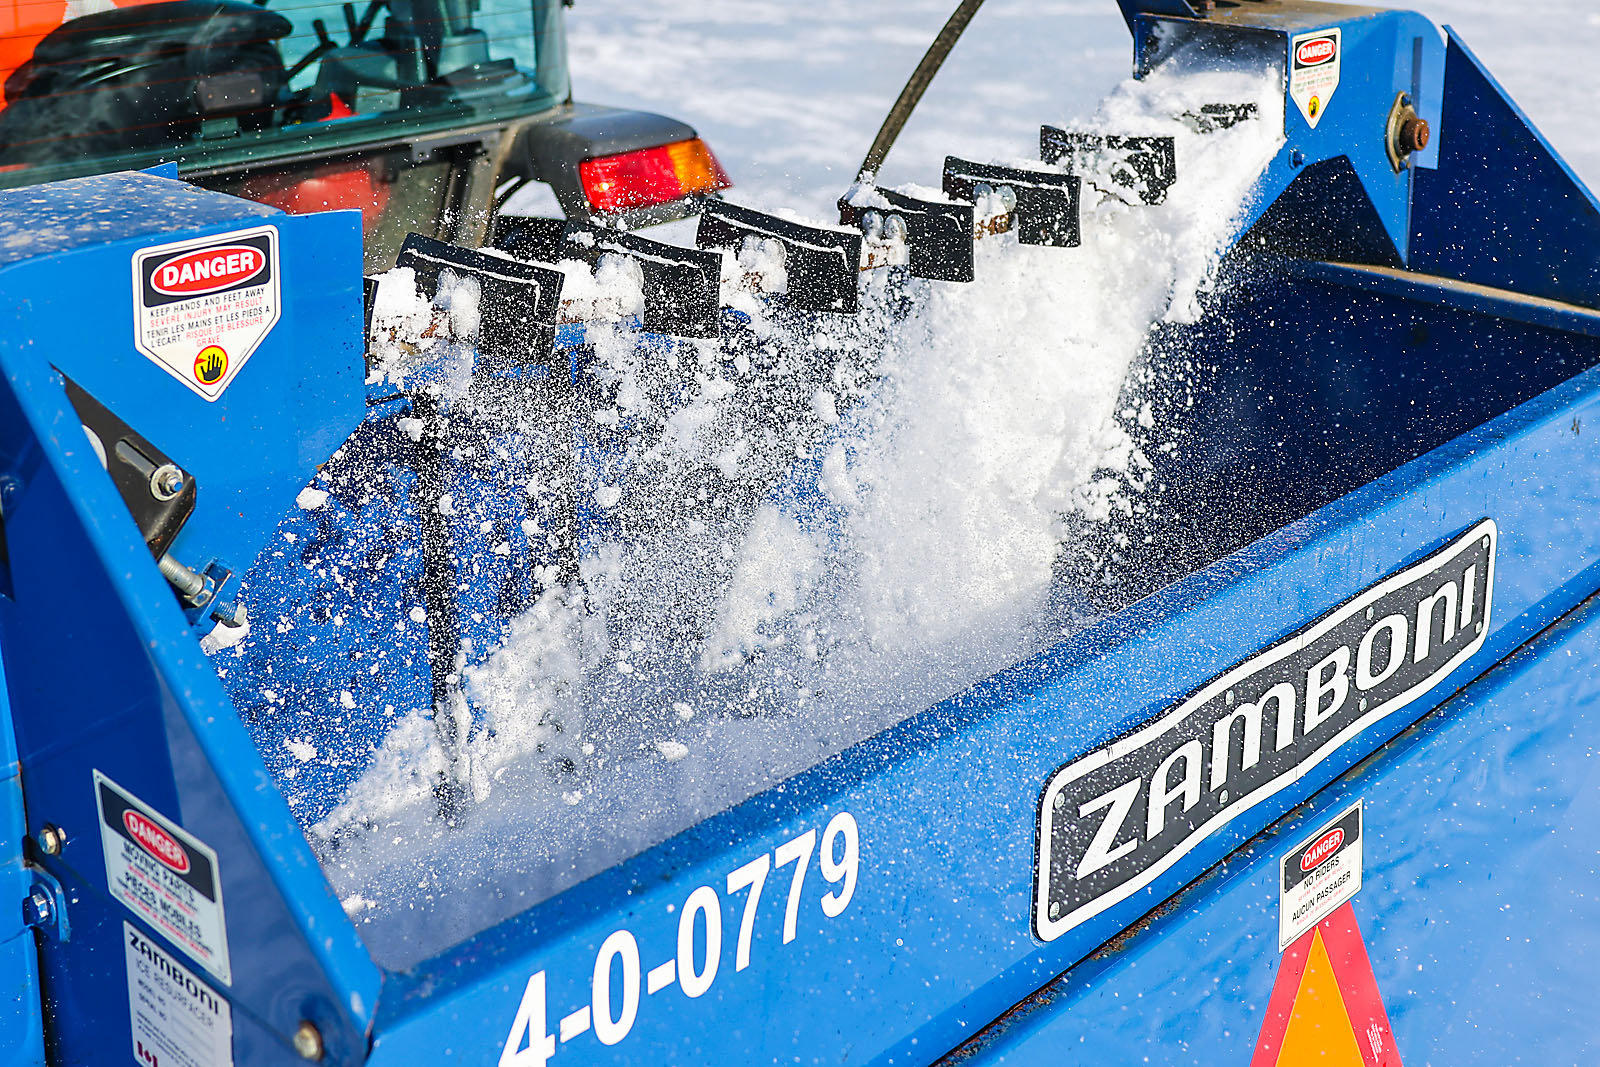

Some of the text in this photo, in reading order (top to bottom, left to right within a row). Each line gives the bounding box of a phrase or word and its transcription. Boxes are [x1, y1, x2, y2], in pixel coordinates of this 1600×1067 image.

[1301, 42, 1332, 60] DANGER
[162, 251, 254, 288] DANGER
[150, 288, 265, 318] KEEP HANDS AND FEET AWAY
[150, 297, 262, 328] SEVERE INJURY MAY RESULT
[146, 327, 168, 340] TENIR
[172, 324, 184, 334] LES
[188, 318, 212, 330] MAINS
[215, 315, 224, 324] ET
[226, 312, 239, 322] LES
[242, 308, 262, 318] PIEDS
[186, 328, 212, 340] RISQUE
[216, 324, 224, 334] DE
[227, 316, 263, 330] BLESSURE
[196, 335, 220, 347] GRAVE
[1076, 564, 1476, 880] ZAMBONI
[129, 814, 184, 866] DANGER
[1304, 832, 1340, 868] DANGER
[124, 842, 159, 876] MOVING
[163, 870, 194, 902] PARTS
[1304, 856, 1340, 890] NO RIDERS
[1292, 870, 1351, 922] AUCUN PASSAGER
[498, 812, 860, 1067] 4-0-0779
[130, 932, 218, 1015] ZAMBONI
[136, 958, 150, 979] ICE
